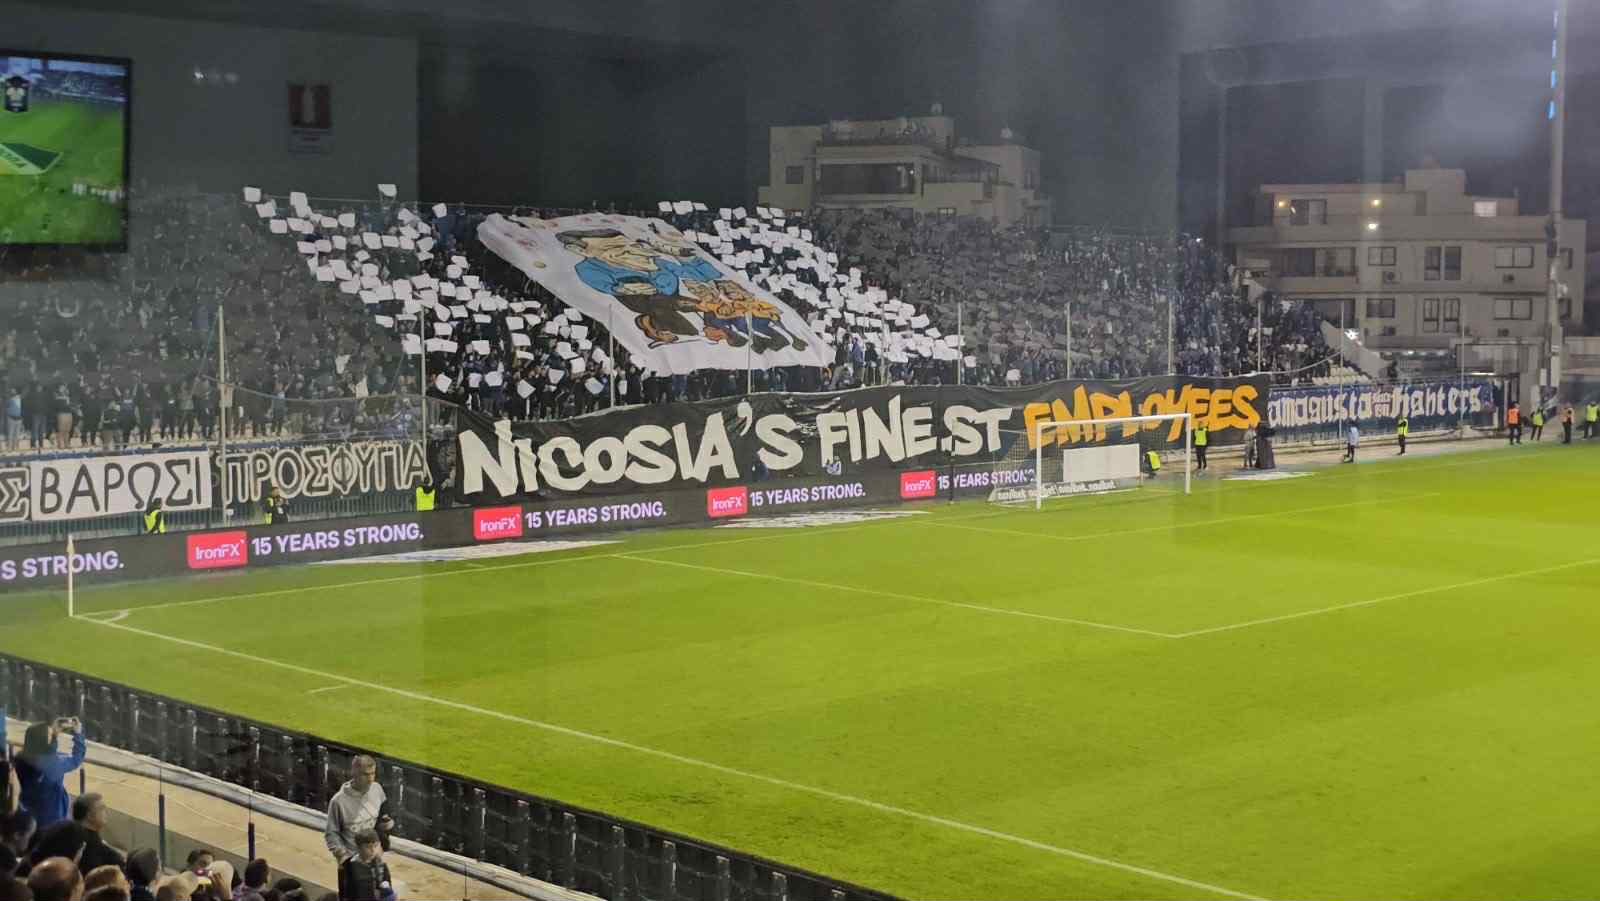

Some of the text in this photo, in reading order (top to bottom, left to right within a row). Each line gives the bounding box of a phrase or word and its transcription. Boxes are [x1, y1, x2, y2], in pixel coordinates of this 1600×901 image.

[1023, 384, 1260, 449] EMPLOYEES
[39, 456, 202, 514] ΒΑΡΩΣΙ
[749, 491, 764, 507] 15
[766, 487, 809, 505] YEARS
[811, 482, 866, 501] STRONG.
[937, 475, 950, 490] 15
[952, 472, 989, 488] YEARS
[480, 501, 667, 533] IronFX 15 YEARS STRONG.
[195, 522, 425, 561] IronFX 15 YEARS STRONG.
[22, 550, 125, 578] STRONG.
